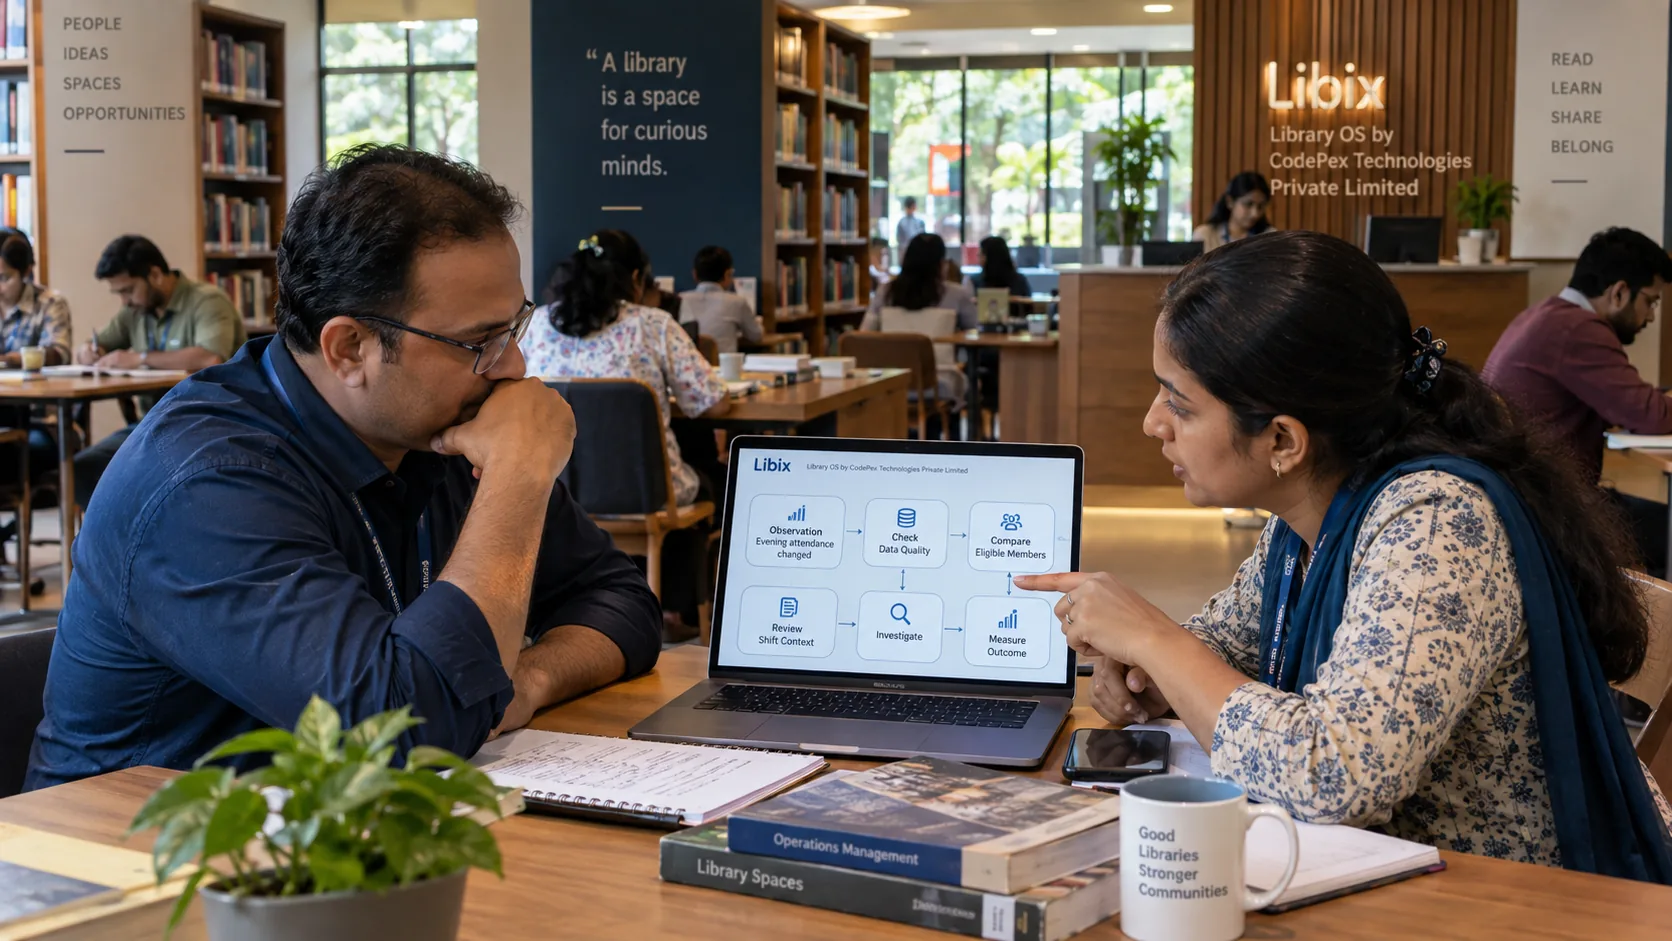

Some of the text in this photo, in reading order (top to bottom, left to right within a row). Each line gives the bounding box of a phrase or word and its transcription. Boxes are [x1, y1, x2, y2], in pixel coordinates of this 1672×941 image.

[63, 17, 122, 31] PEOPLE
[63, 47, 109, 61] IDEAS
[1551, 53, 1594, 66] READ
[623, 50, 687, 79] library
[63, 76, 121, 91] SPACES
[1267, 61, 1385, 110] Libix
[1551, 81, 1603, 95] LEARN
[601, 85, 701, 112] is a space
[63, 107, 185, 121] OPPORTUNITIES
[1551, 110, 1602, 124] SHARE
[601, 118, 708, 141] for curious
[1270, 125, 1394, 147] Library OS by
[1551, 140, 1614, 154] BELONG
[601, 154, 668, 176] minds.
[1269, 152, 1472, 174] CodePex Technologies
[1270, 178, 1419, 196] Private Limited
[754, 457, 791, 473] Libix
[806, 463, 828, 472] Library
[840, 464, 848, 472] by
[879, 465, 920, 474] Technologies
[769, 526, 823, 537] Observation
[891, 532, 919, 543] Check
[756, 537, 834, 549] Evening attendance
[990, 536, 1031, 548] Compare
[777, 549, 812, 560] changed
[879, 545, 931, 557] Data Quality
[975, 548, 1047, 560] Eligible Members
[772, 623, 803, 634] Review
[758, 636, 815, 647] Shift Context
[876, 630, 923, 643] Investigate
[988, 635, 1026, 645] Measure
[987, 648, 1027, 659] Outcome
[1139, 826, 1175, 842] Good
[773, 833, 919, 866] Operations Management
[1139, 845, 1199, 862] Libraries
[697, 859, 804, 892] Library Spaces
[1139, 864, 1198, 883] Stronger
[1139, 883, 1228, 899] Communities
